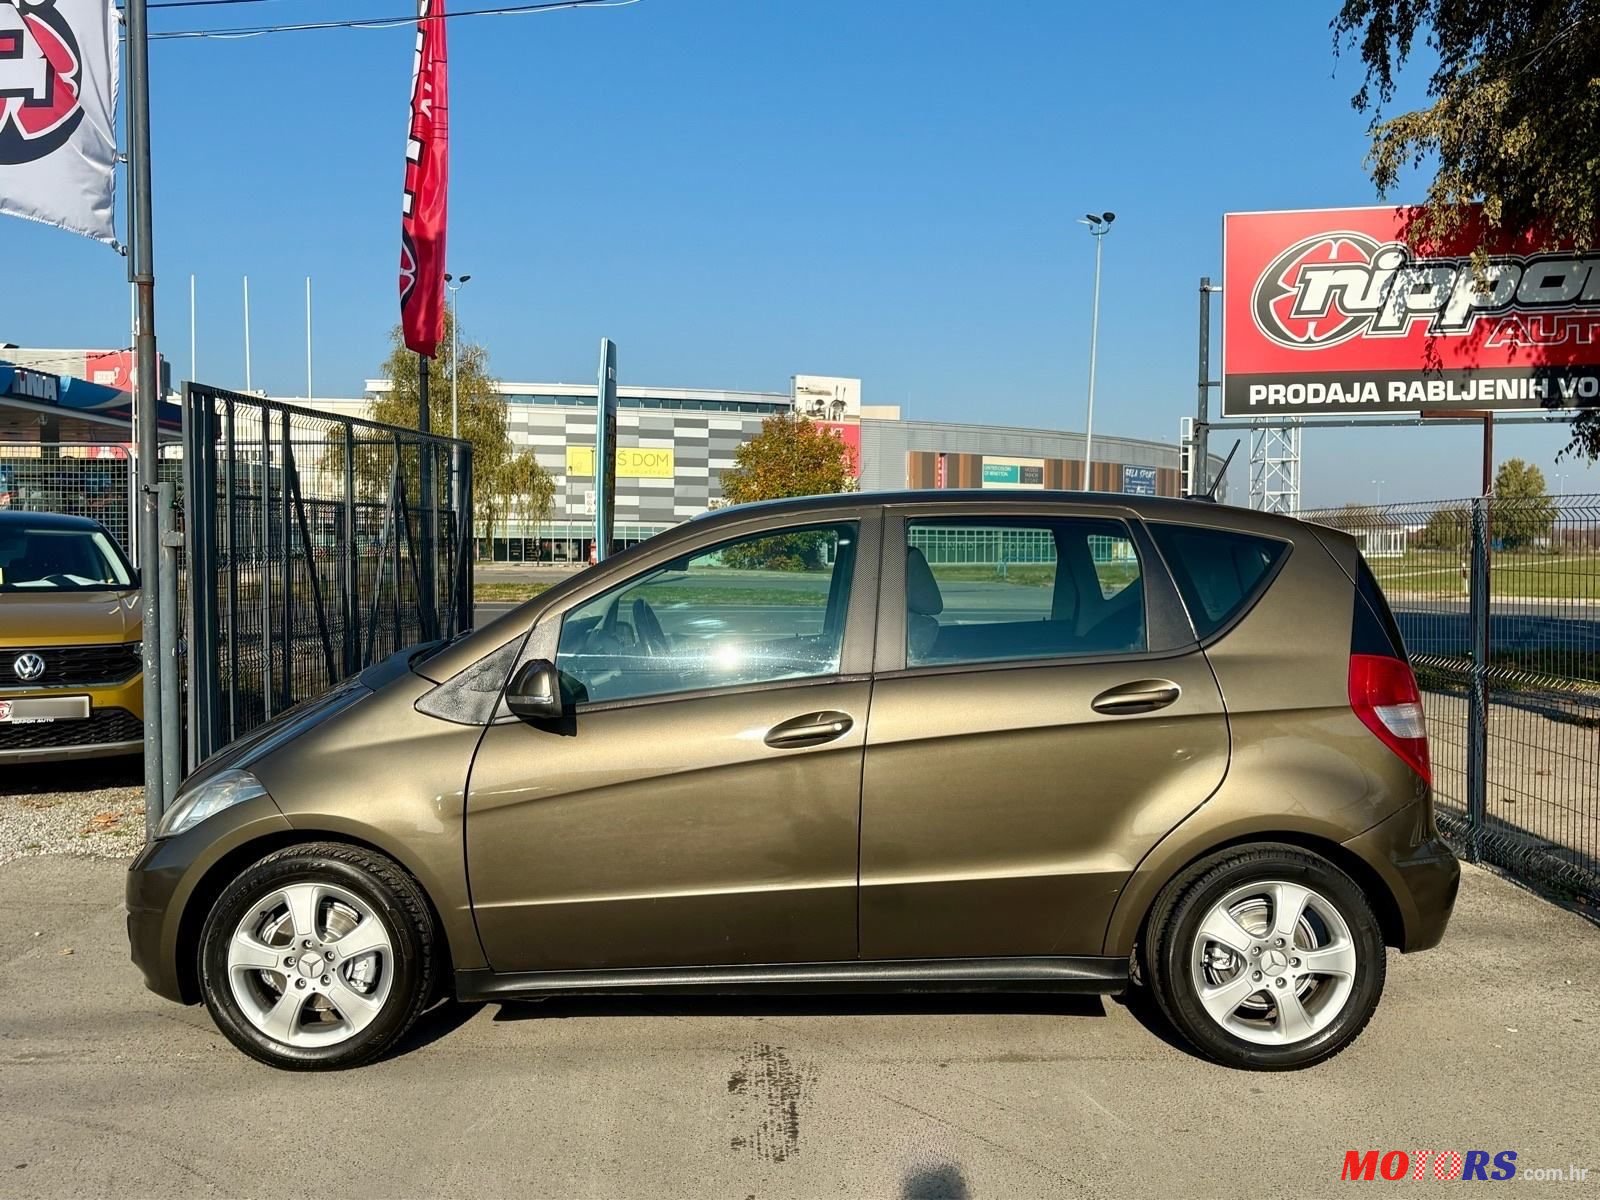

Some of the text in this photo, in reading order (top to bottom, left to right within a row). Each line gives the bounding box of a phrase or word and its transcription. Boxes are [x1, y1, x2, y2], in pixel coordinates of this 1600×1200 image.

[1250, 376, 1600, 405] PRODAJA RABLJENIH VO
[632, 453, 669, 467] DOM
